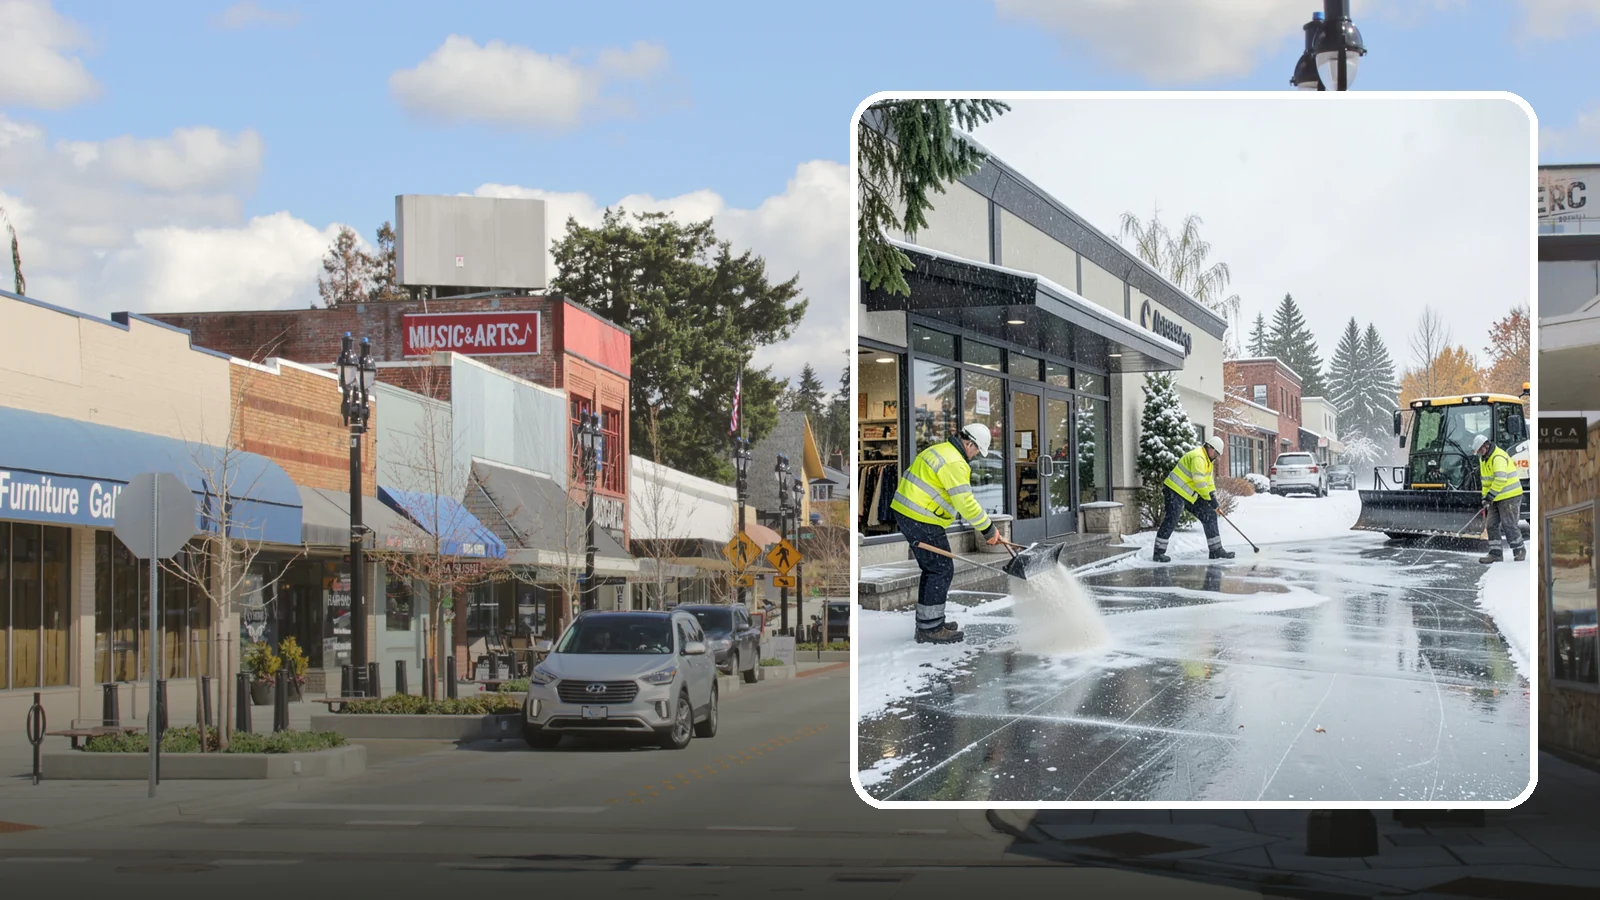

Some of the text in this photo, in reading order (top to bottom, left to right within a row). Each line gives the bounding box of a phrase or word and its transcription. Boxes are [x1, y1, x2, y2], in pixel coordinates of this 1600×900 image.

[0, 471, 122, 519] Furniture Gal
[453, 563, 479, 574] SUSHI
